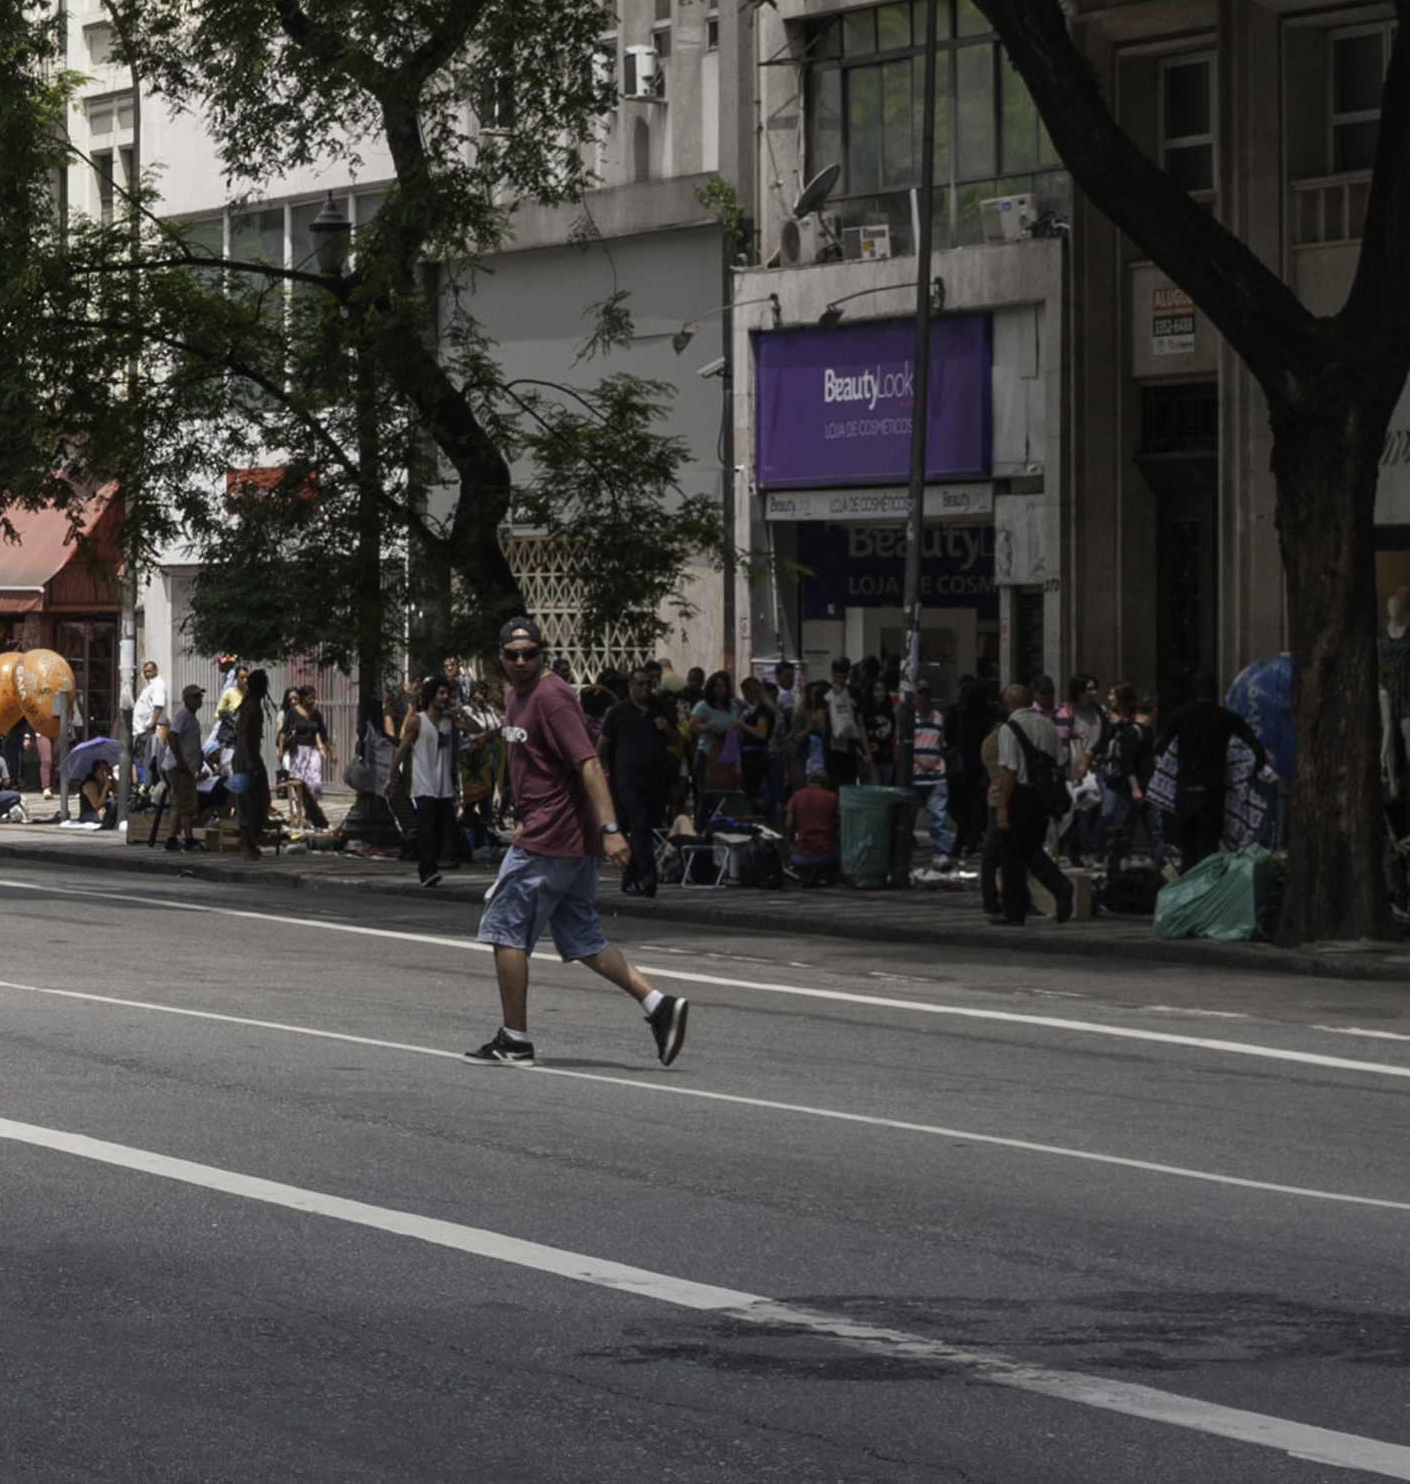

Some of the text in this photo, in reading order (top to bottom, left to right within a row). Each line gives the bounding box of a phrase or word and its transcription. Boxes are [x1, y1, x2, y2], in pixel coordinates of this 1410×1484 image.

[1154, 288, 1194, 307] ALUG
[823, 360, 914, 411] BeautyLook
[824, 416, 914, 439] LOJA DE COSMÉTICOS
[830, 497, 848, 514] LOJA
[850, 497, 859, 512] DE
[848, 575, 901, 596] LOJA
